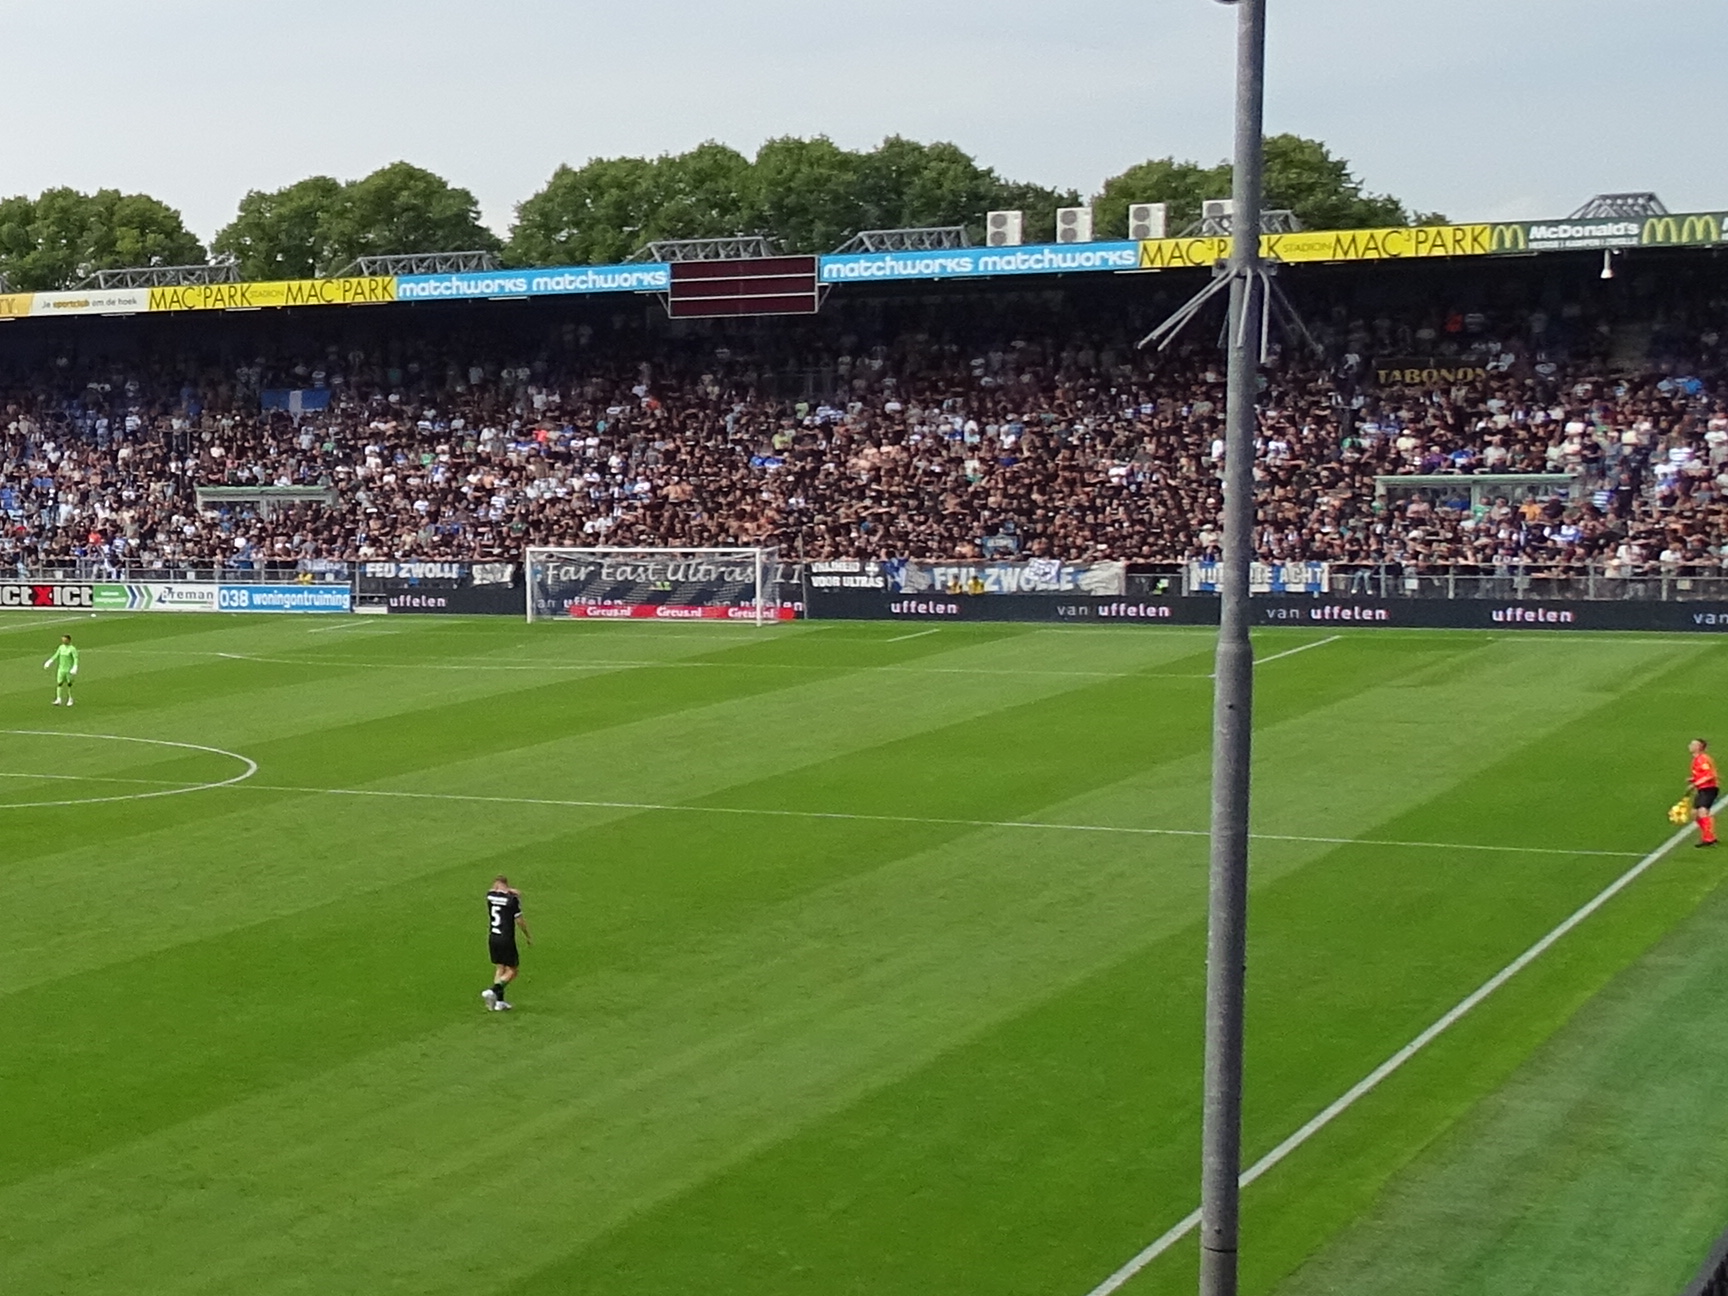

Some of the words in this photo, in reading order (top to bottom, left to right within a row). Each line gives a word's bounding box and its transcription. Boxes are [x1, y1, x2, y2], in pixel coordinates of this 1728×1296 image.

[1529, 222, 1640, 239] McDonald's
[823, 256, 972, 278] matchworks
[978, 248, 1136, 271] matchworks
[399, 277, 527, 297] matchworks
[532, 270, 666, 291] matchworks
[547, 562, 595, 584] Far
[601, 562, 661, 583] East
[667, 562, 754, 583] Ultras
[811, 576, 840, 587] VOOR
[843, 576, 884, 588] ULTRAS
[218, 589, 248, 607] 038
[252, 590, 350, 610] woningontruiming
[389, 594, 446, 608] uffelen
[890, 601, 958, 614] uffelen
[1057, 604, 1088, 615] van
[1098, 603, 1170, 617] uffelen
[1266, 607, 1299, 619] van
[1310, 606, 1387, 620] uffelen
[1491, 607, 1573, 623] uffelen
[491, 906, 502, 927] 5
